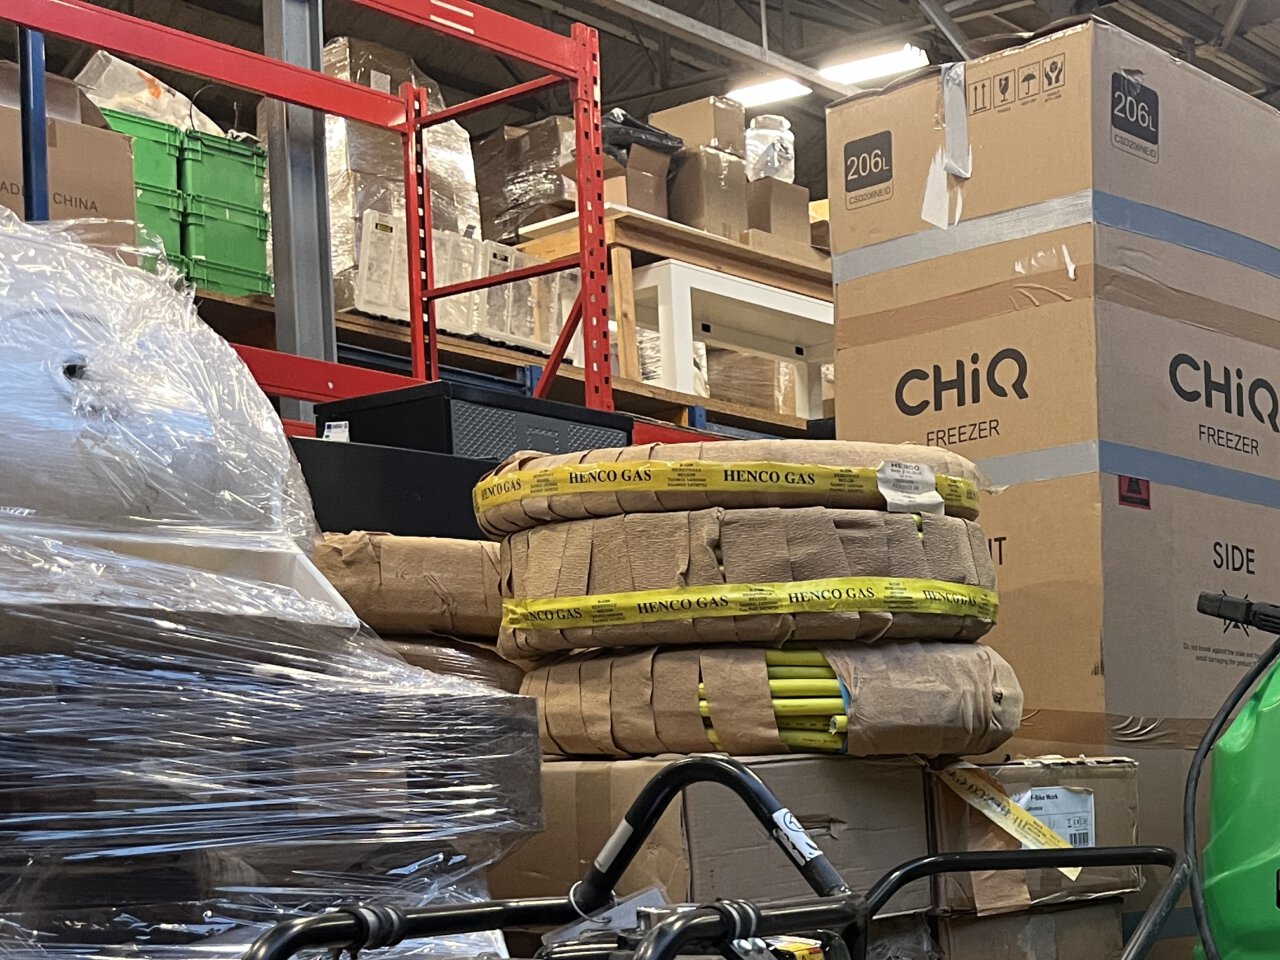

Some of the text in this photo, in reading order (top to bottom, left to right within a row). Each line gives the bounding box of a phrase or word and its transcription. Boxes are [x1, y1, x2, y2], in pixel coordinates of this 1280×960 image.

[1113, 91, 1156, 132] 206L
[847, 149, 890, 180] 206L
[53, 192, 98, 213] CHINA
[895, 347, 1029, 416] CHiQ
[1169, 353, 1280, 433] CHiQ
[926, 419, 1000, 447] FREEZER
[1198, 424, 1260, 457] FREEZER
[503, 478, 522, 493] GAS
[569, 470, 617, 484] HENCO
[621, 469, 652, 482] GAS
[723, 469, 780, 484] HENCO
[784, 471, 815, 485] GAS
[1213, 541, 1255, 575] SIDE
[636, 598, 692, 615] HENCO
[696, 595, 729, 609] GAS
[788, 588, 842, 604] HENCO
[846, 587, 875, 599] GAS
[556, 607, 582, 620] GAS
